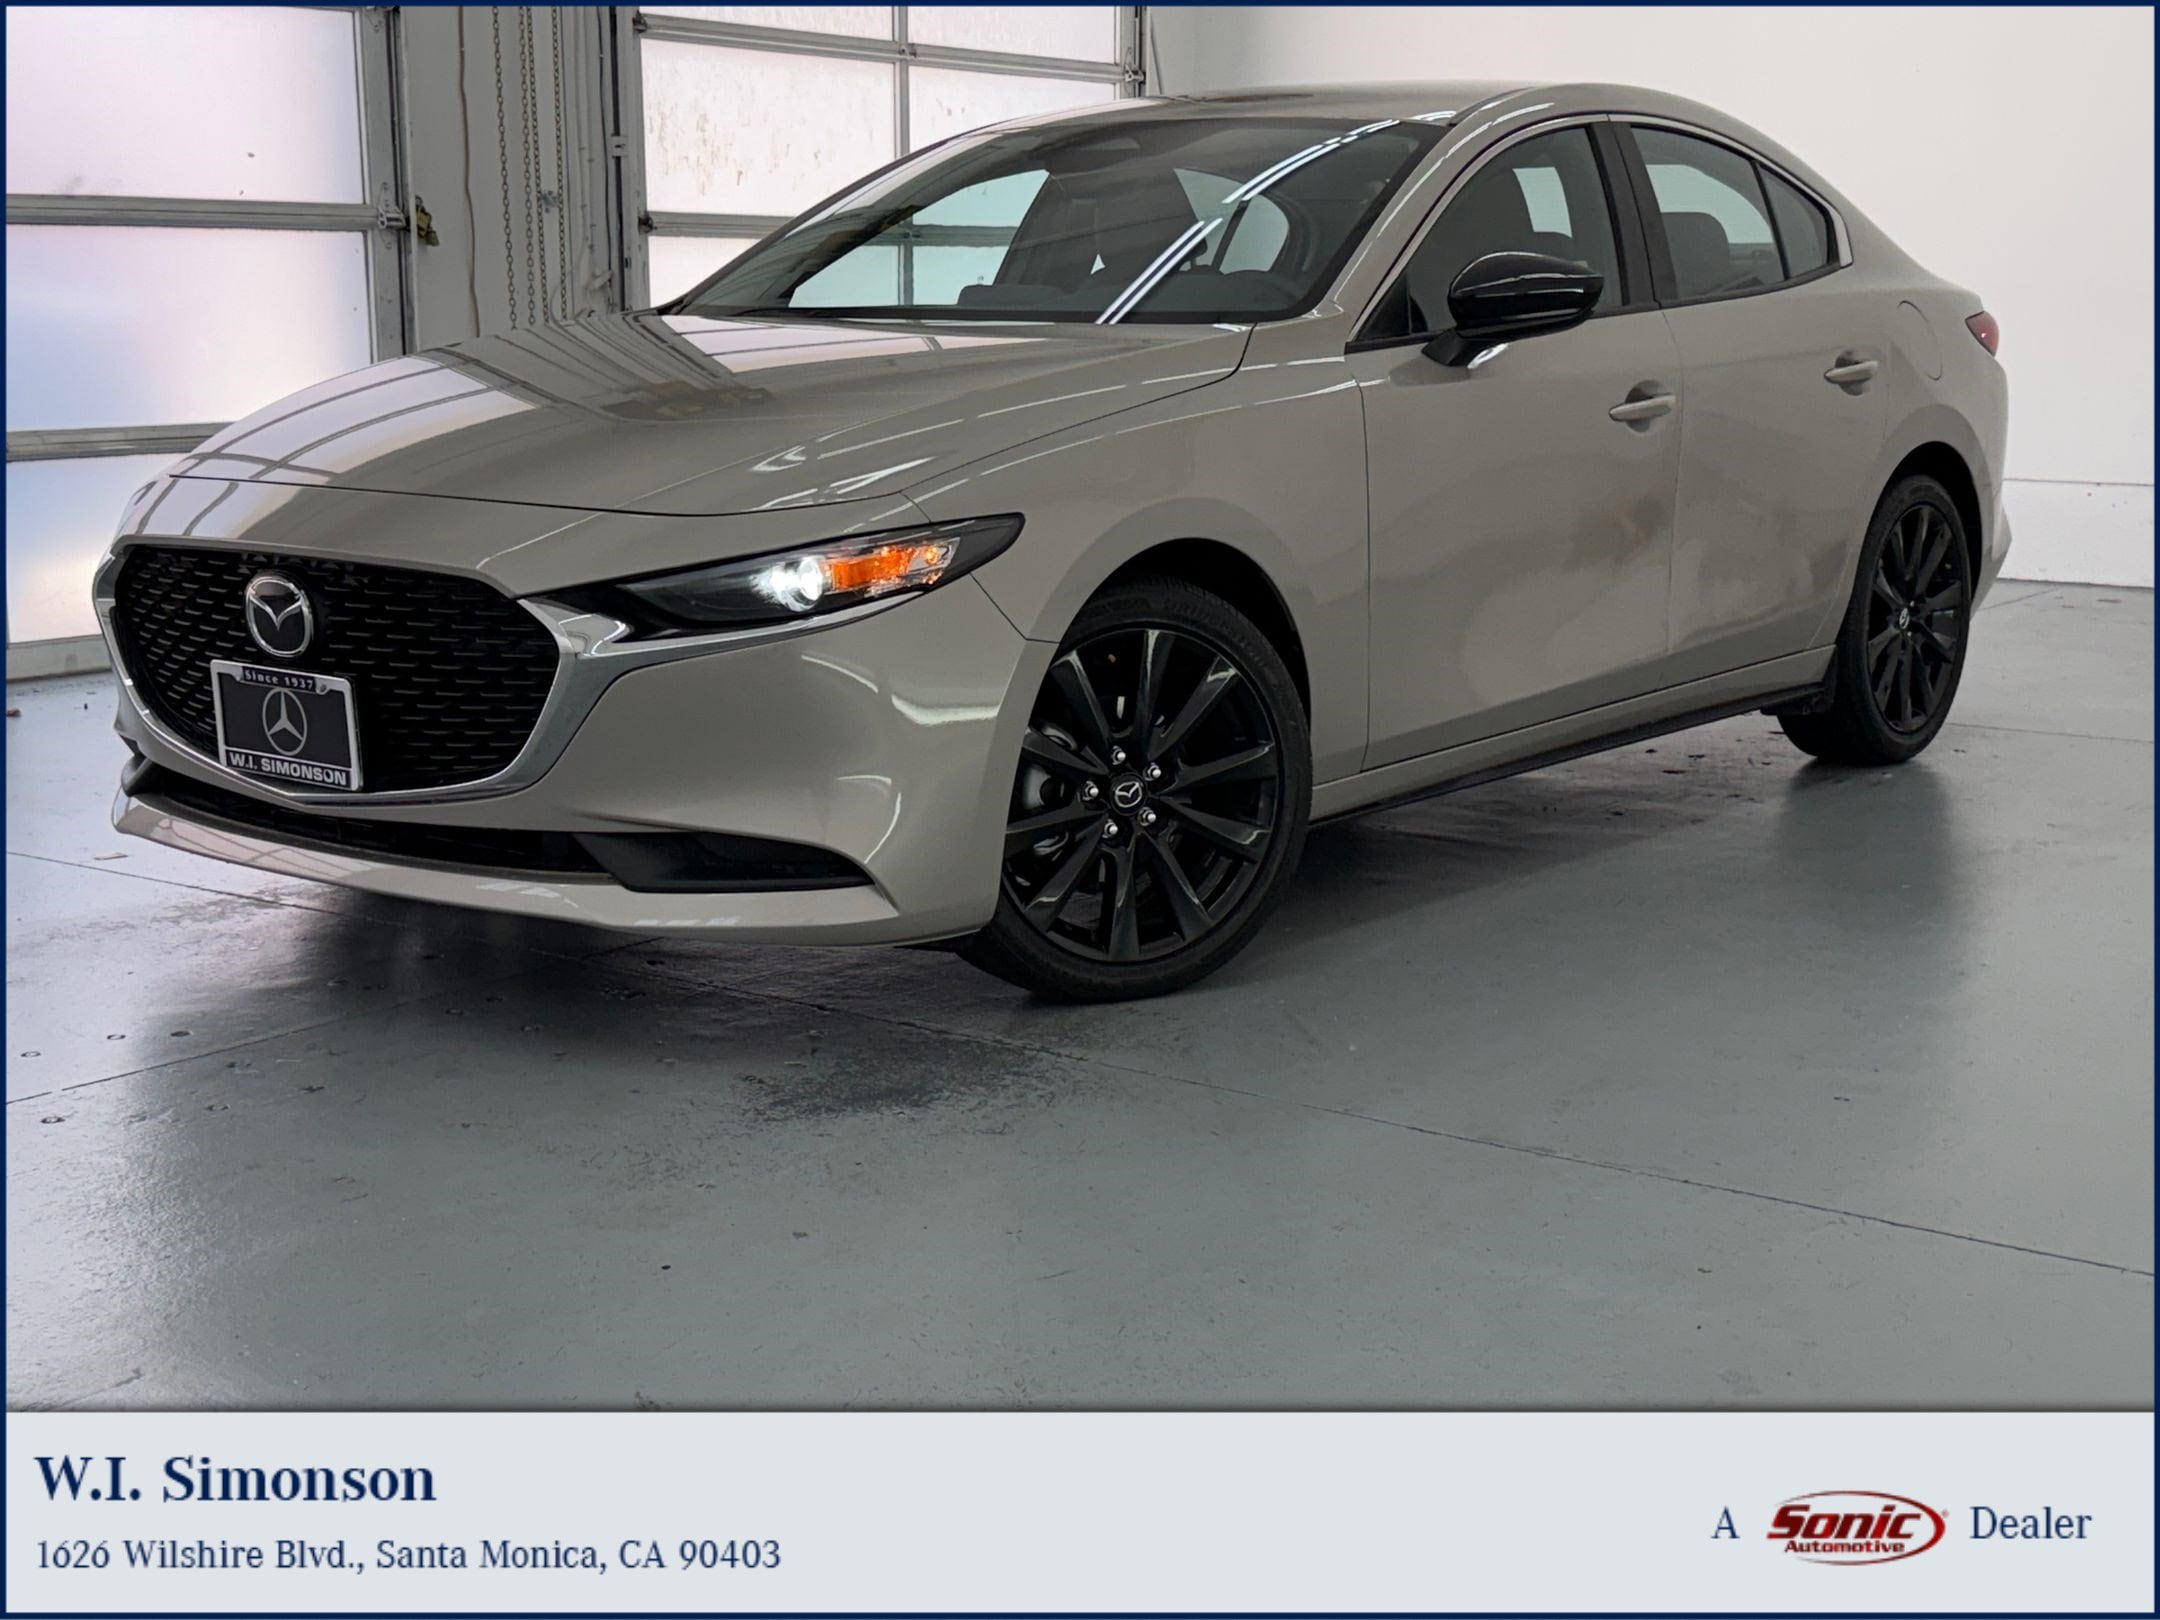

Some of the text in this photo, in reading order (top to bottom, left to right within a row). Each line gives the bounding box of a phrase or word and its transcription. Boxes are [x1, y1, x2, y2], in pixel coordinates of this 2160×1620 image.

[244, 669, 314, 690] Since 1937
[229, 751, 347, 786] W.I. SIMONSON
